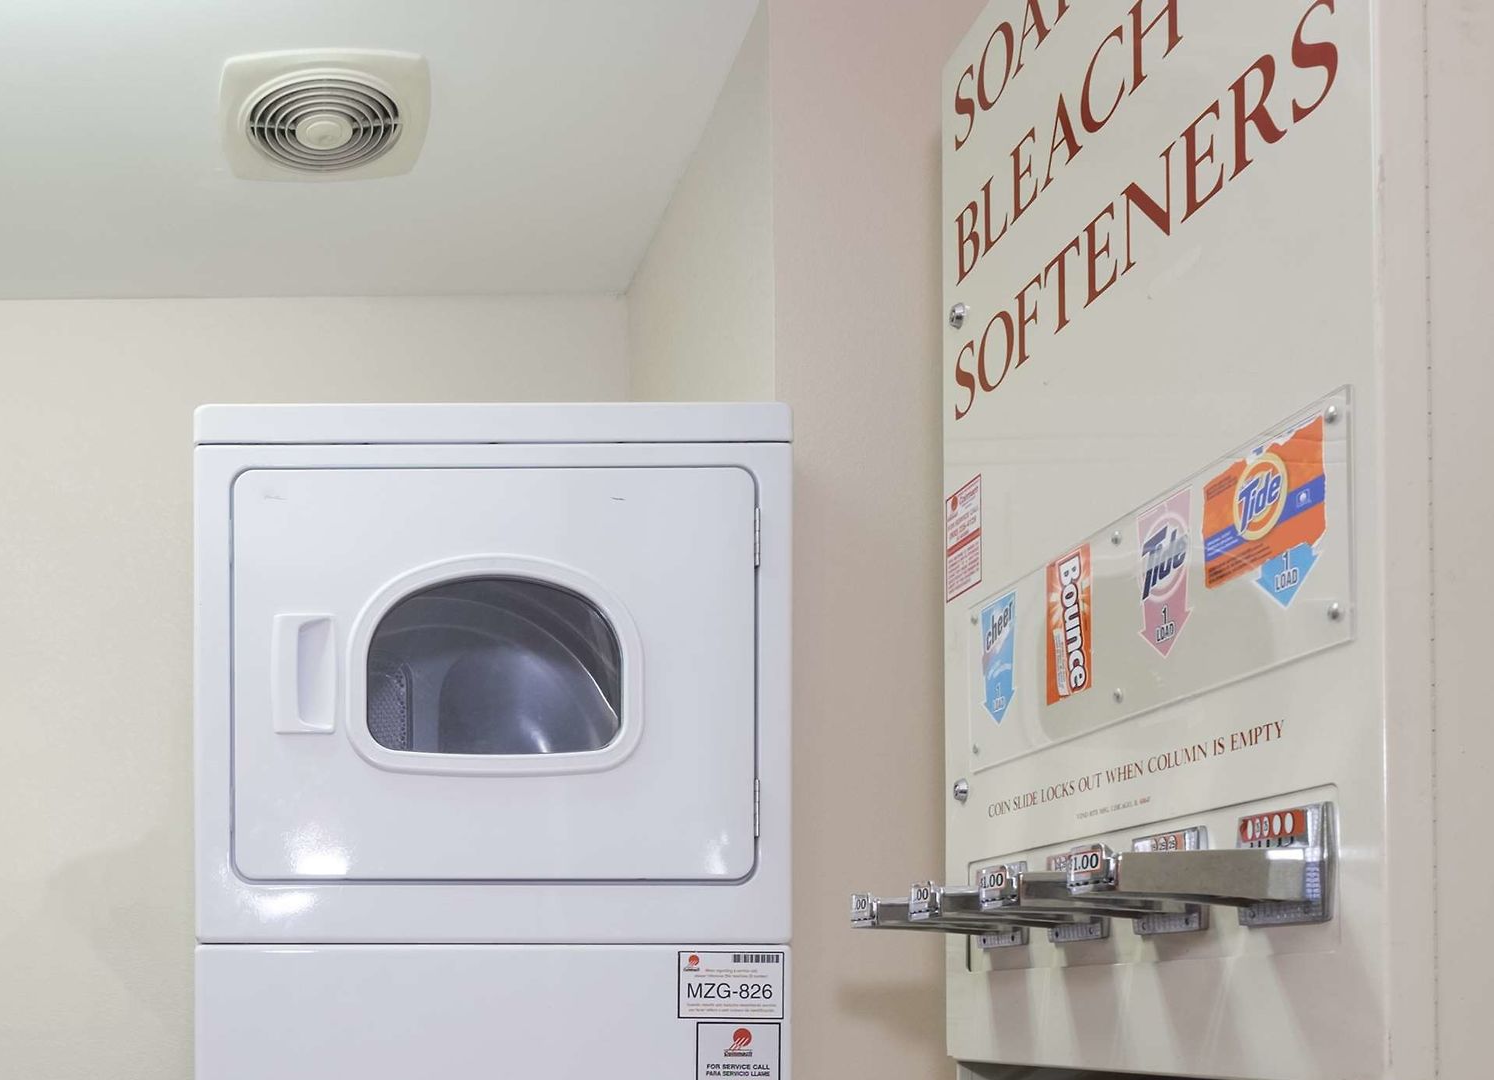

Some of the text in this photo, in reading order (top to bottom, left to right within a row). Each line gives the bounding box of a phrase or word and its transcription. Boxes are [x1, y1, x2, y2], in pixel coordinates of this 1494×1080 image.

[955, 0, 1069, 151] SOA
[955, 0, 1183, 286] BLEACH
[955, 0, 1339, 420] SOFTENERS
[1238, 470, 1282, 534] Tide
[1142, 526, 1187, 600] Tide
[1275, 569, 1298, 590] LOAD
[1282, 552, 1290, 569] 1
[986, 602, 1014, 651] cheer
[1058, 554, 1087, 690] Bounce
[1156, 623, 1174, 642] LOAD
[1161, 607, 1168, 624] 1
[988, 719, 1285, 818] COIN SLIDE LOCKS OUT WHEN COLUMN IS EMPTY
[687, 983, 773, 999] MZG-826
